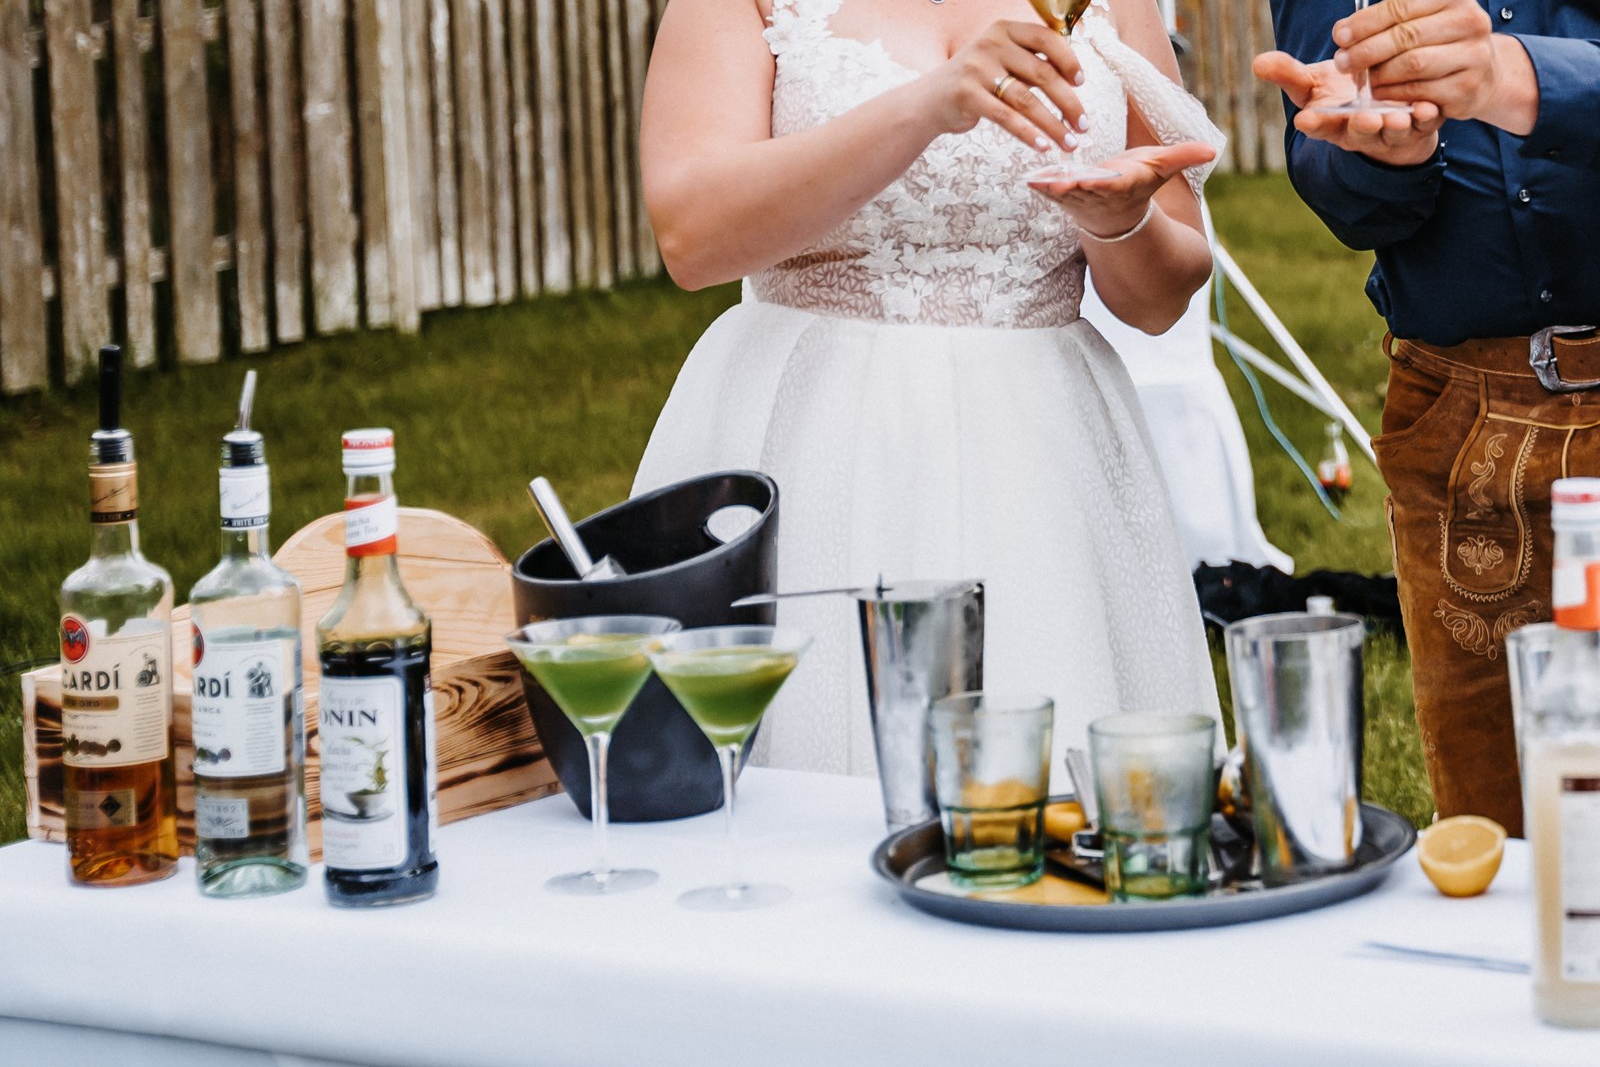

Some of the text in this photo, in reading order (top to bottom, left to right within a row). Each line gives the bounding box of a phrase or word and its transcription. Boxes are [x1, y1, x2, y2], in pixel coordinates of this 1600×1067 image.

[231, 518, 252, 527] WHITE
[79, 700, 100, 708] ORO
[211, 805, 237, 814] 1862
